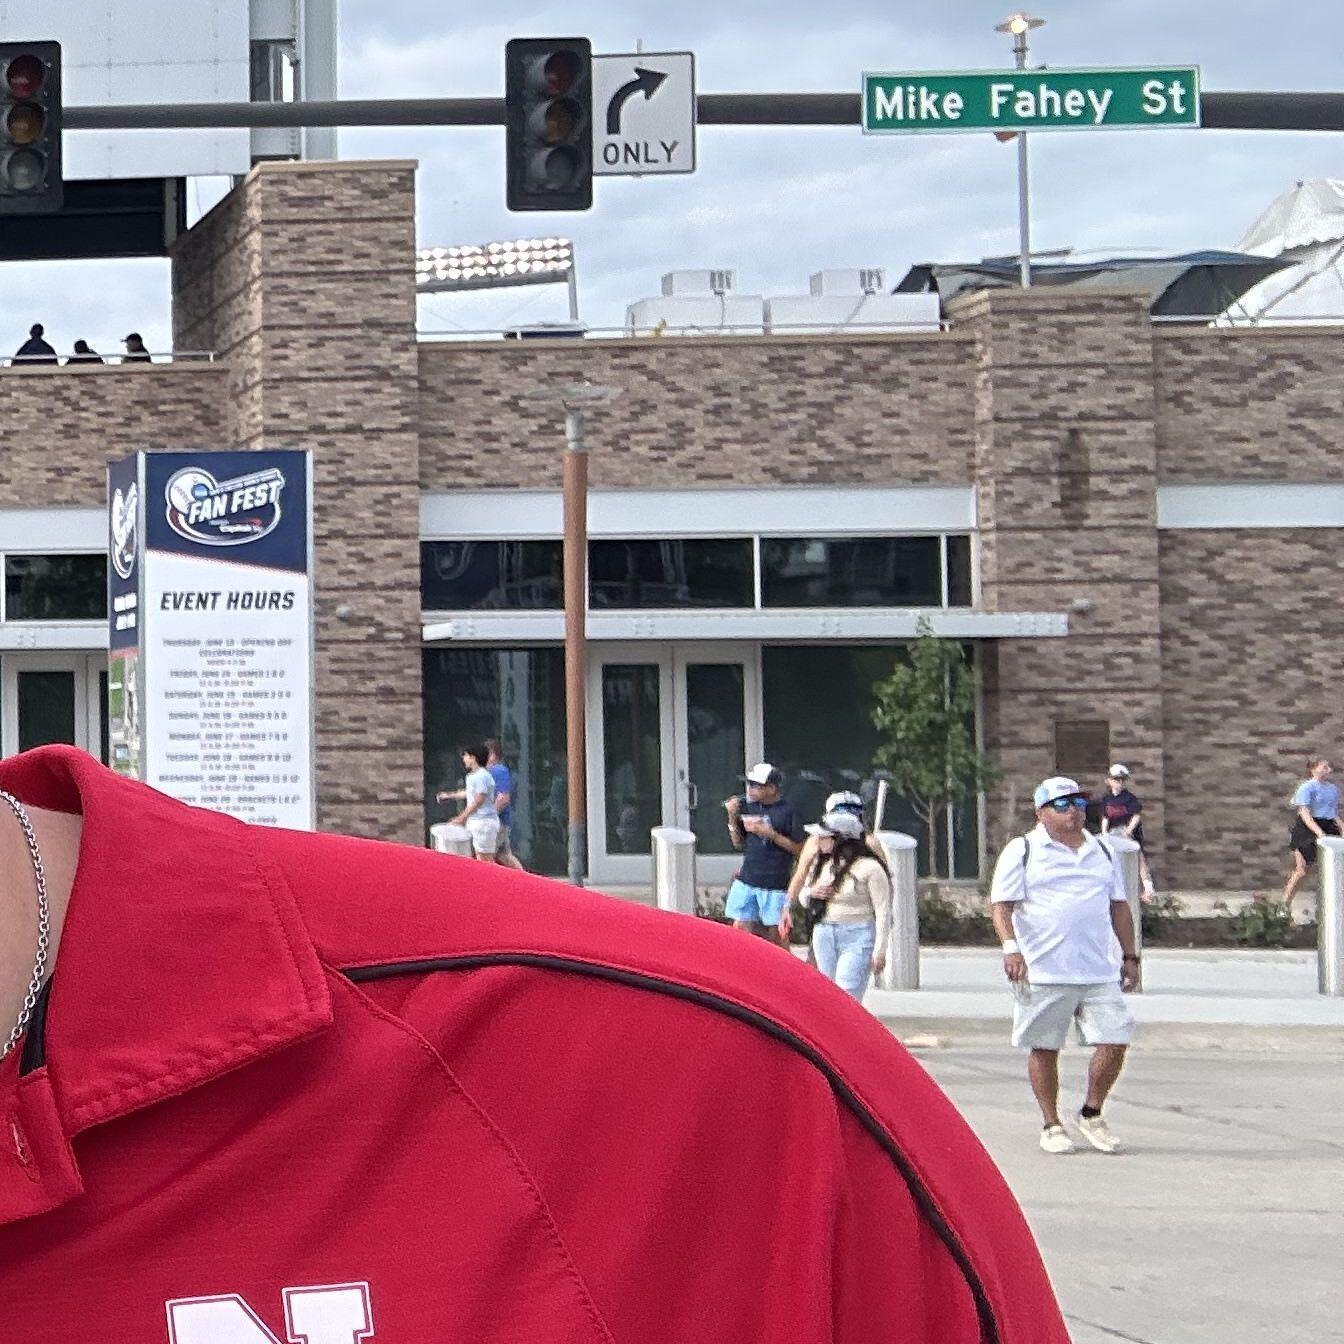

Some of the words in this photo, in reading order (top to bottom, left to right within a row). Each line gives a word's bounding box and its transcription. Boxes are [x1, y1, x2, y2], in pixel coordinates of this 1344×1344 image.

[874, 84, 964, 121] Mike
[989, 82, 1114, 126] Fahey
[1141, 79, 1187, 116] St
[603, 139, 680, 166] ONLY
[188, 493, 228, 525] FAN
[231, 479, 283, 514] FEST
[160, 590, 222, 611] EVENT
[226, 590, 296, 611] HOURS
